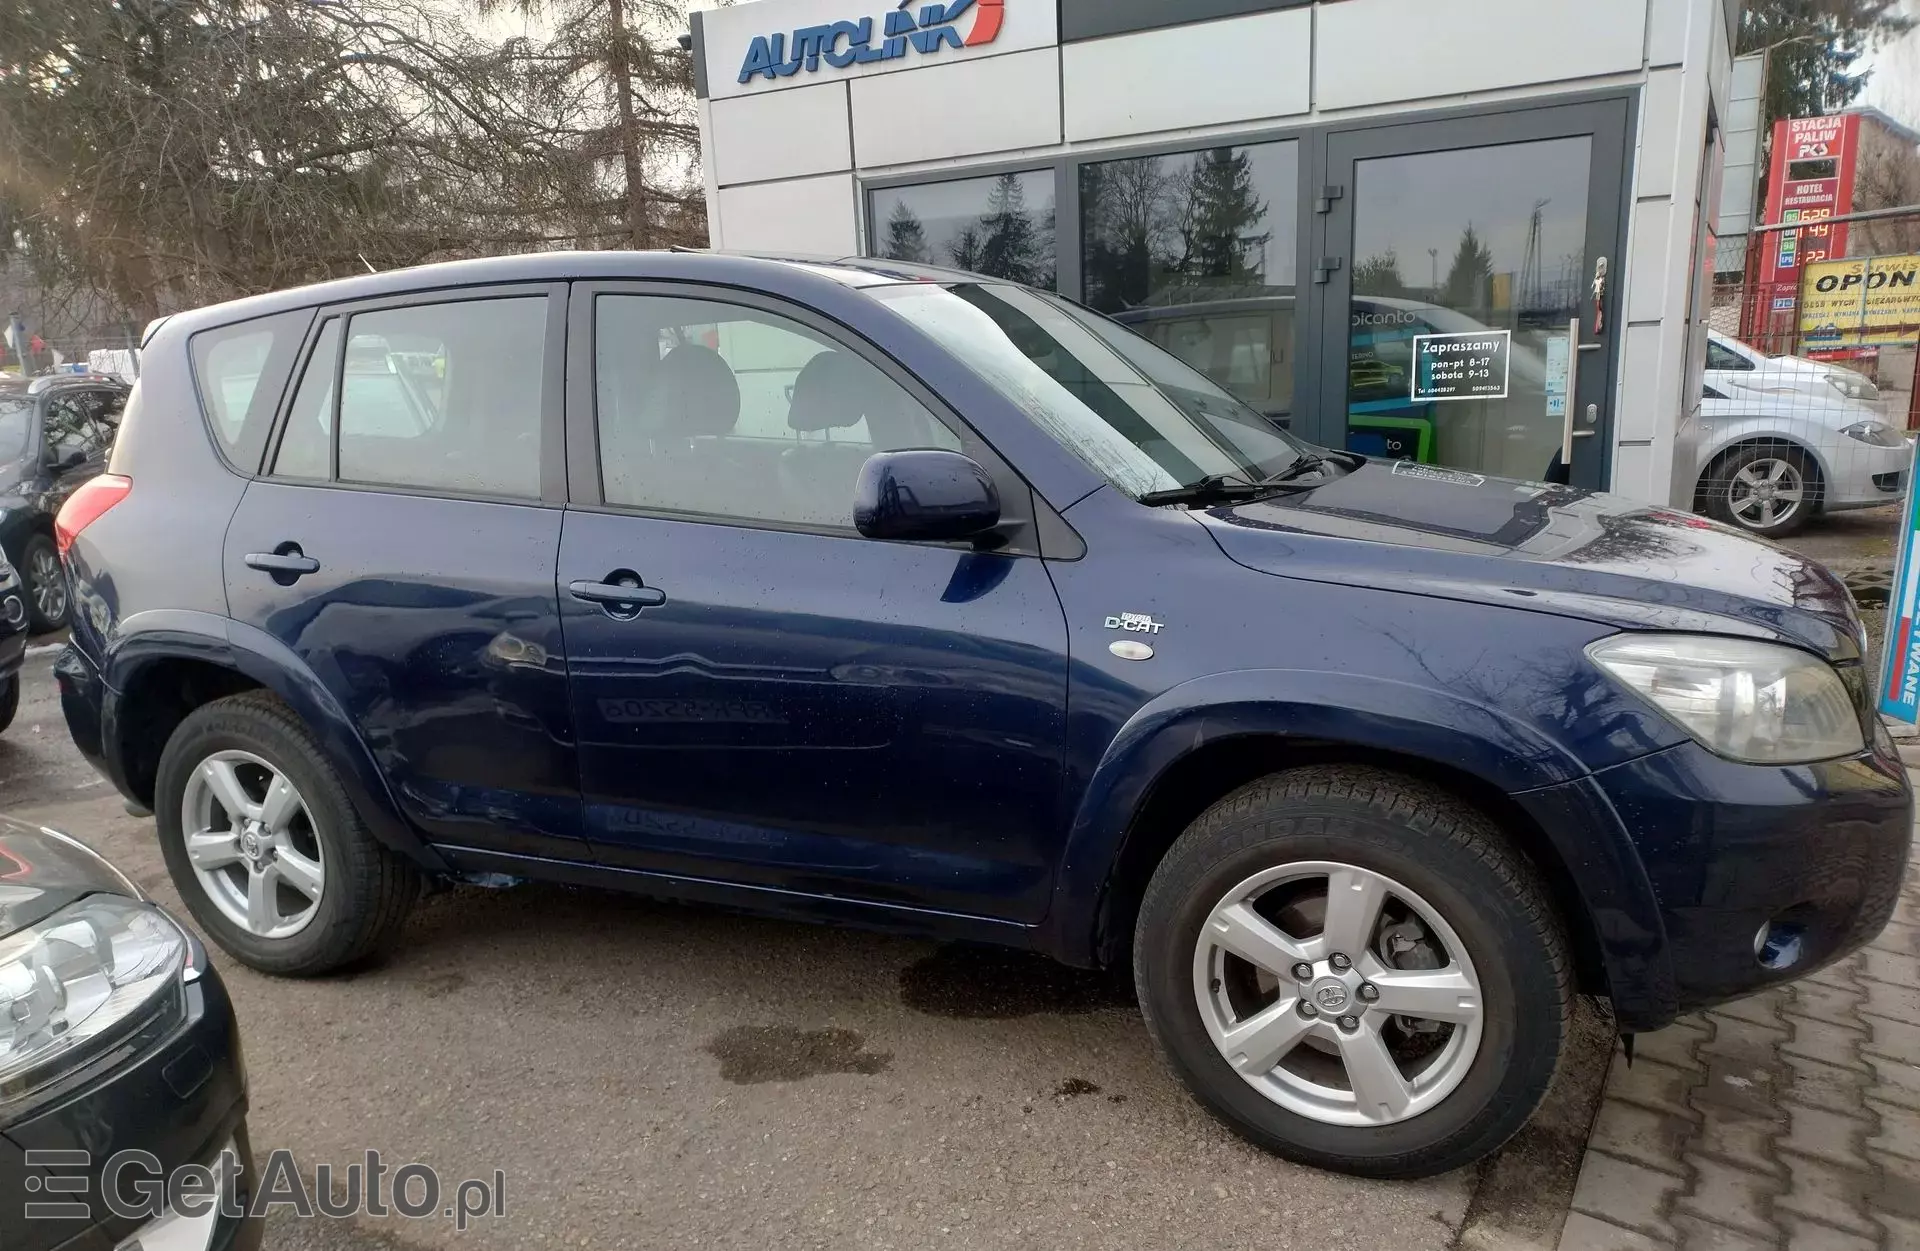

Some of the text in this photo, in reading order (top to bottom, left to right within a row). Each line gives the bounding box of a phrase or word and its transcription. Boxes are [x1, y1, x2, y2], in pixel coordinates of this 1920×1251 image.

[737, 0, 976, 84] AUTOLINK
[1792, 118, 1841, 132] STACJA
[1795, 130, 1837, 144] PALIW
[1796, 184, 1823, 195] HOTEL
[1785, 194, 1833, 205] RESTAURACJA
[1816, 271, 1916, 292] OPON
[1422, 340, 1500, 356] Zapraszamy
[1431, 357, 1490, 371] pon-pt 8-17
[1431, 369, 1490, 380] sobota 9-13
[1104, 616, 1165, 634] D-CAT
